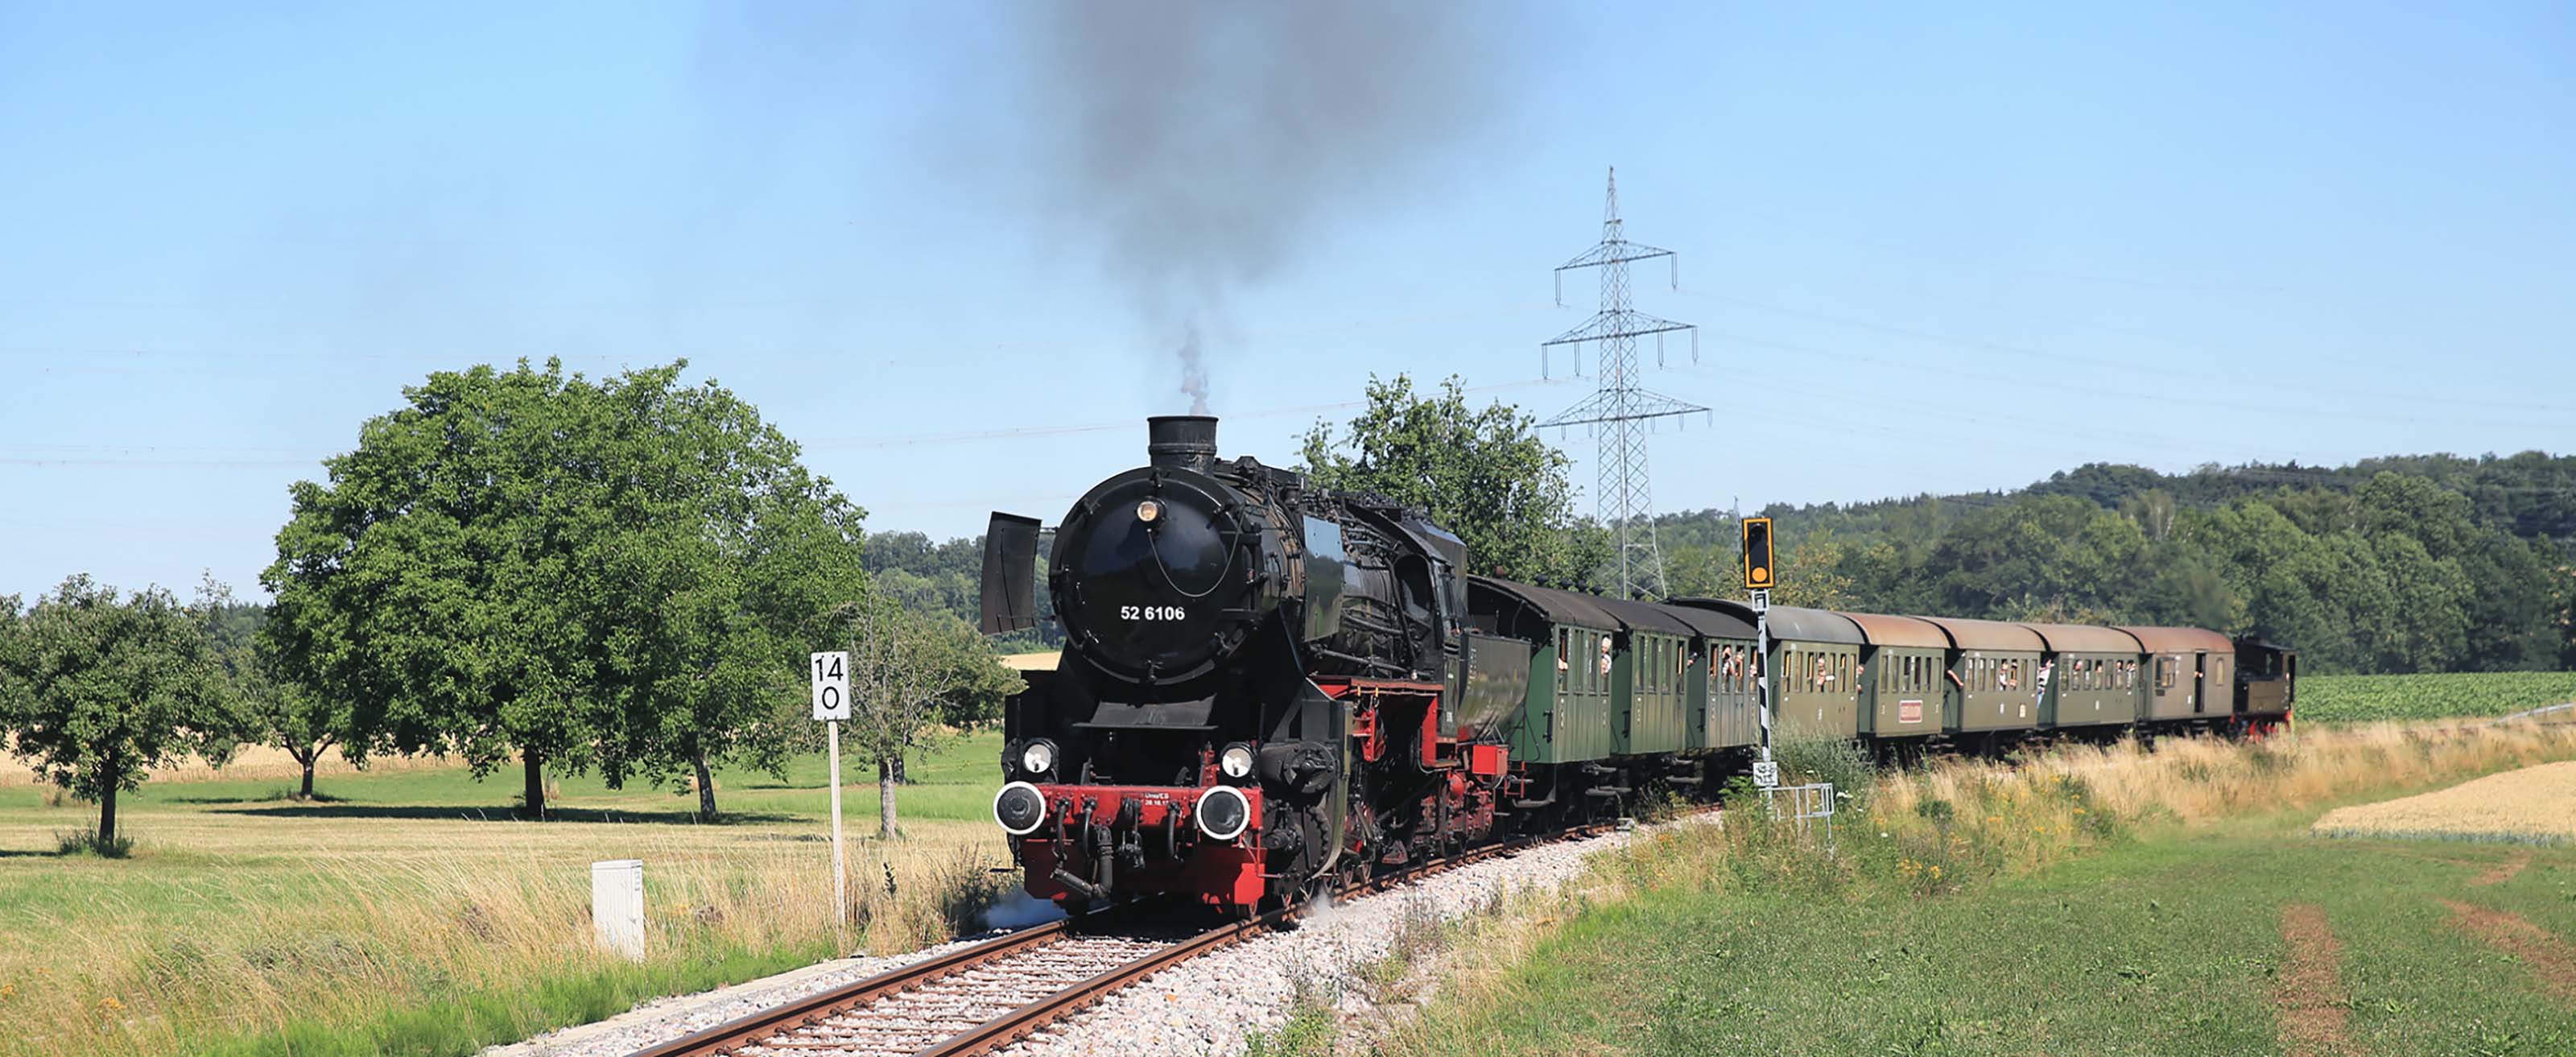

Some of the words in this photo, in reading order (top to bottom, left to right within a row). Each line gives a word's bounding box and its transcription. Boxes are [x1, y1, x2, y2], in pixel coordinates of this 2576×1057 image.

[1121, 605, 1140, 620] 52
[1145, 605, 1185, 620] 6106
[815, 657, 844, 682] 14
[822, 686, 840, 710] 0
